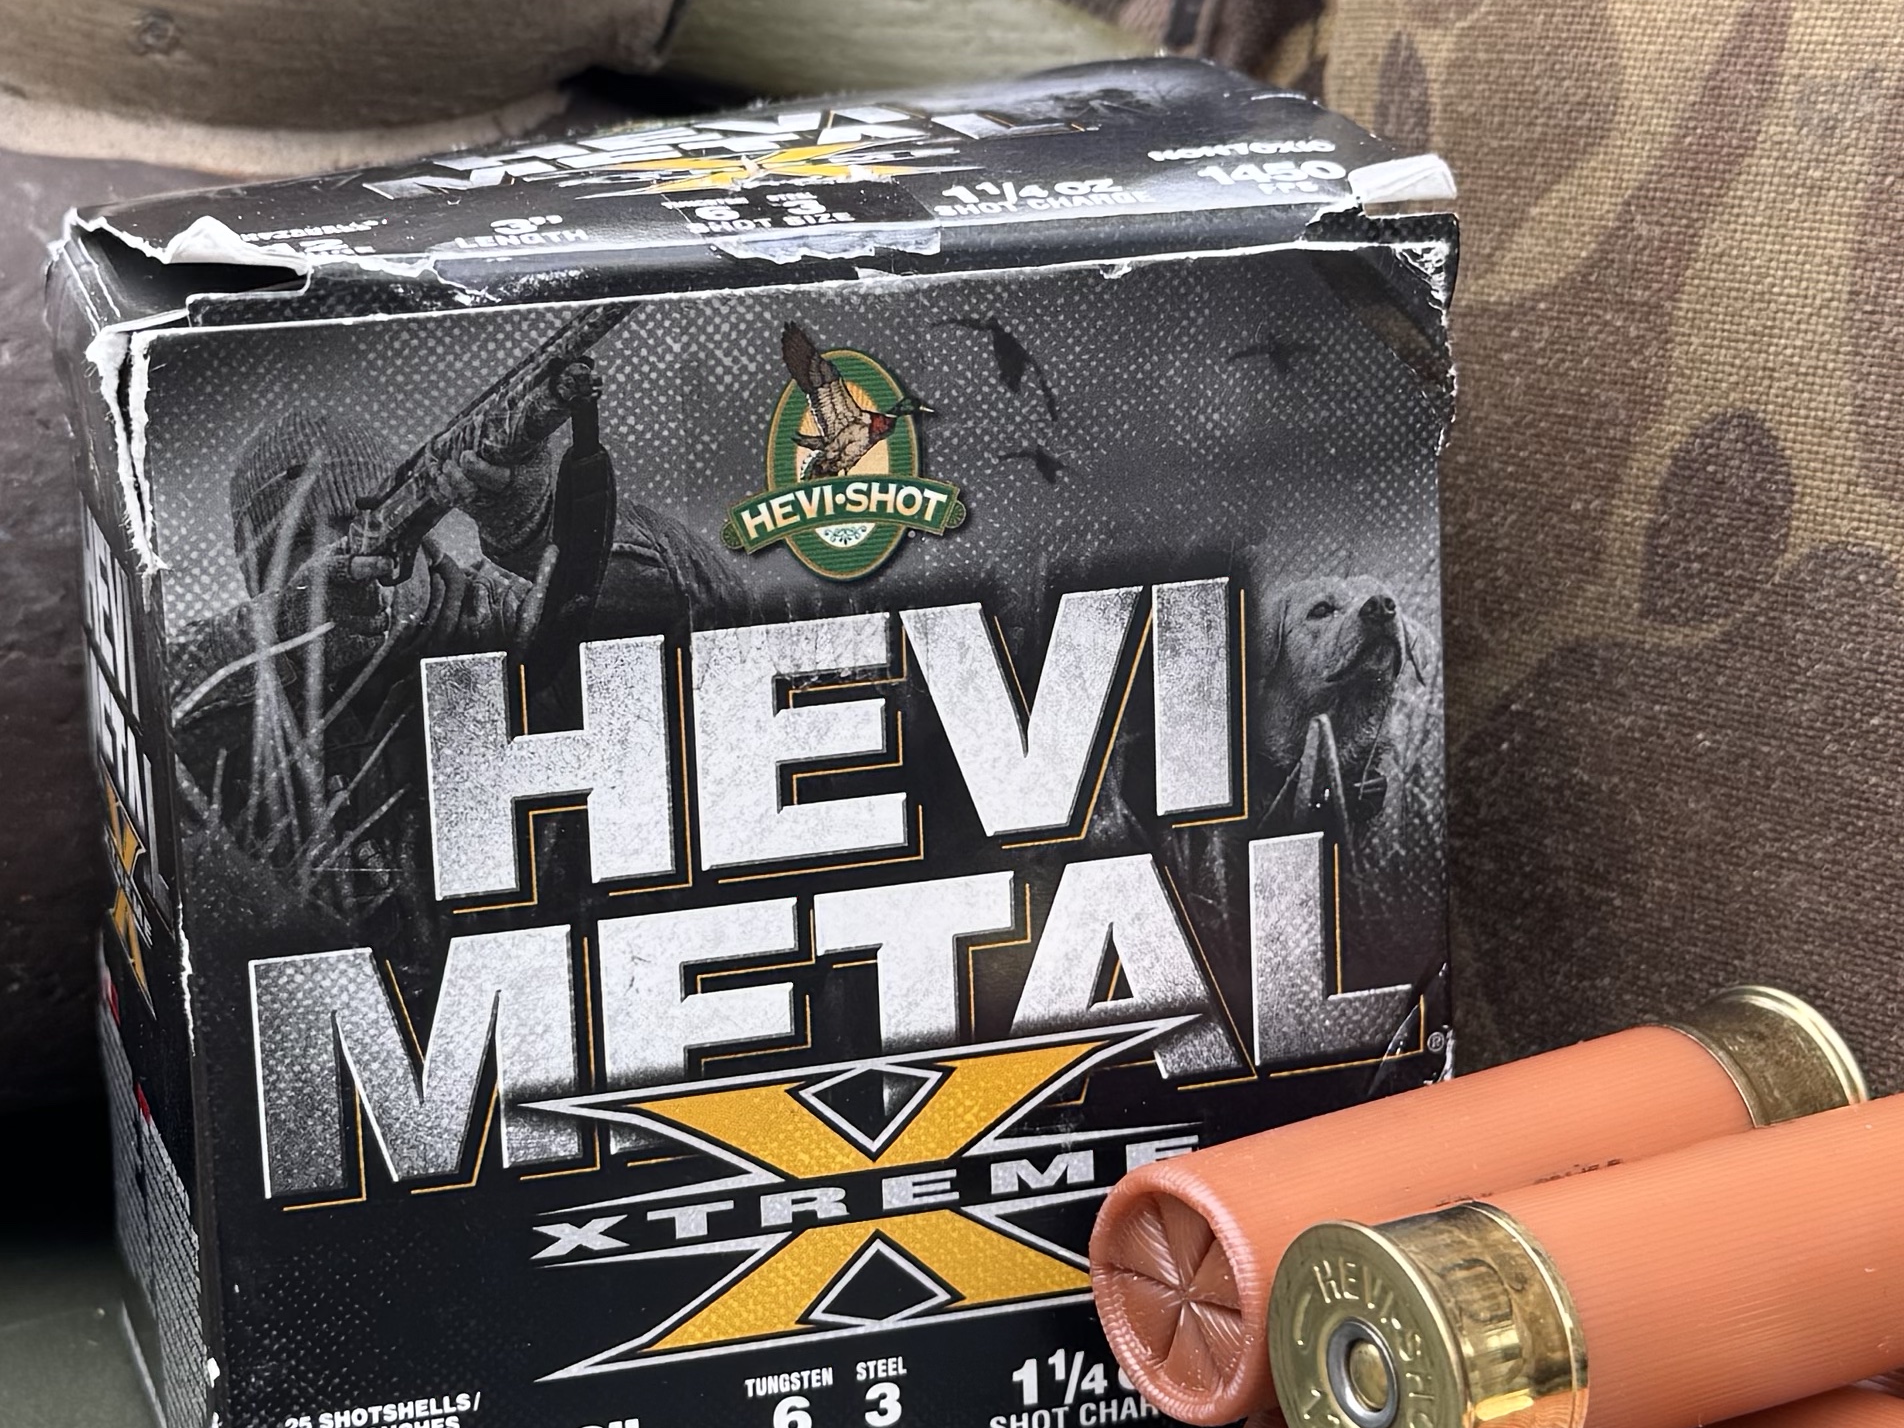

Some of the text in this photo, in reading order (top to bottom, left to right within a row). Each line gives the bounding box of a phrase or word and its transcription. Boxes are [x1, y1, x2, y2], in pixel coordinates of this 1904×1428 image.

[1197, 159, 1347, 185] 1450
[1053, 178, 1124, 196] OZ
[694, 199, 827, 221] 6 3
[933, 189, 1156, 217] SHOT CHARGE
[685, 211, 856, 234] SHOT SIZE
[454, 228, 589, 249] LENGTH
[419, 575, 1233, 902] HEVI
[247, 831, 1415, 1200] METAL
[529, 1134, 1200, 1260] XTREME
[744, 1367, 834, 1398] TUNGSTEN
[856, 1356, 908, 1382] STEEL
[864, 1382, 903, 1428] 3
[1079, 1396, 1162, 1427] CHAR
